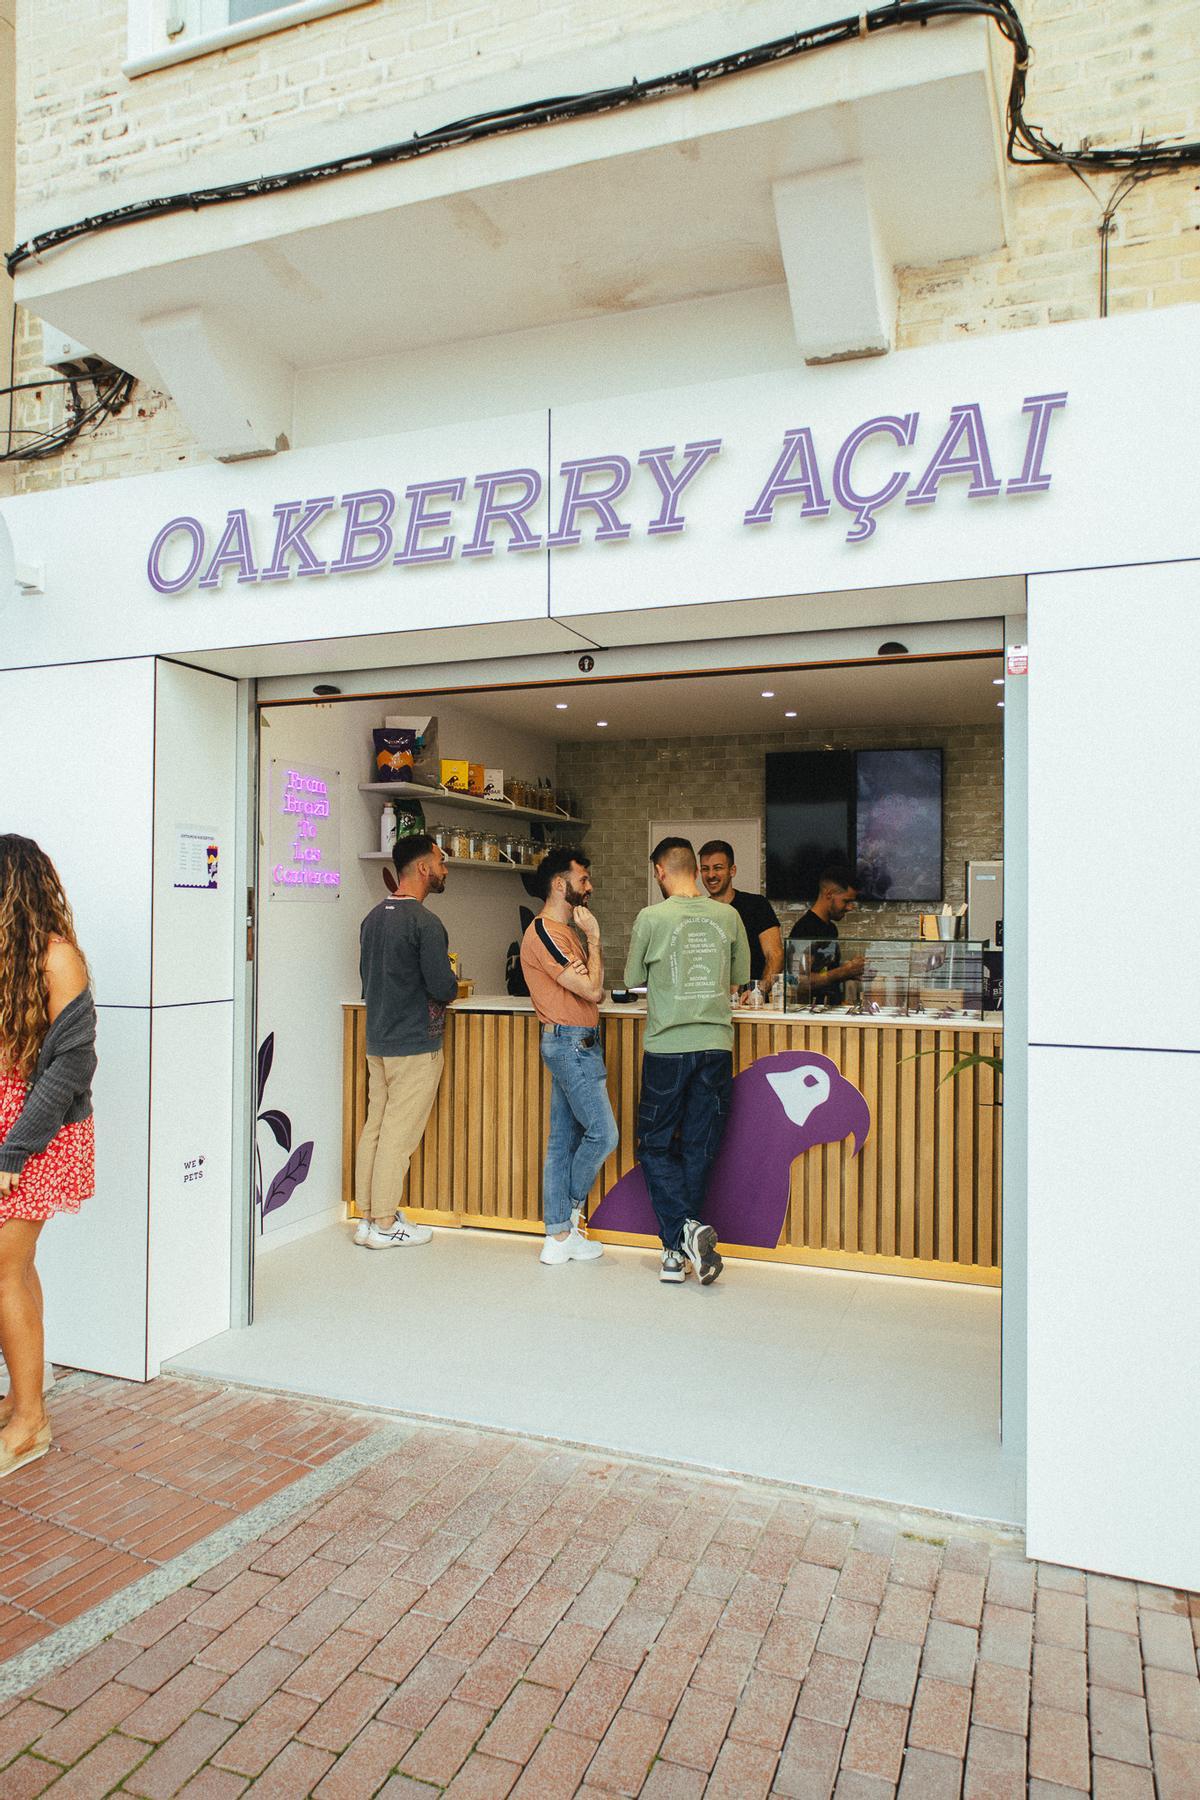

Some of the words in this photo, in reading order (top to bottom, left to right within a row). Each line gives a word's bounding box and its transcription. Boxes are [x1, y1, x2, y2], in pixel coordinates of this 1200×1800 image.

[147, 439, 722, 594] OAKBERRY
[743, 391, 1068, 543] AÇAI
[287, 770, 327, 793] From
[283, 793, 330, 817] Brazil
[297, 820, 318, 838] To
[184, 1160, 196, 1169] WE
[184, 1170, 203, 1183] PETS
